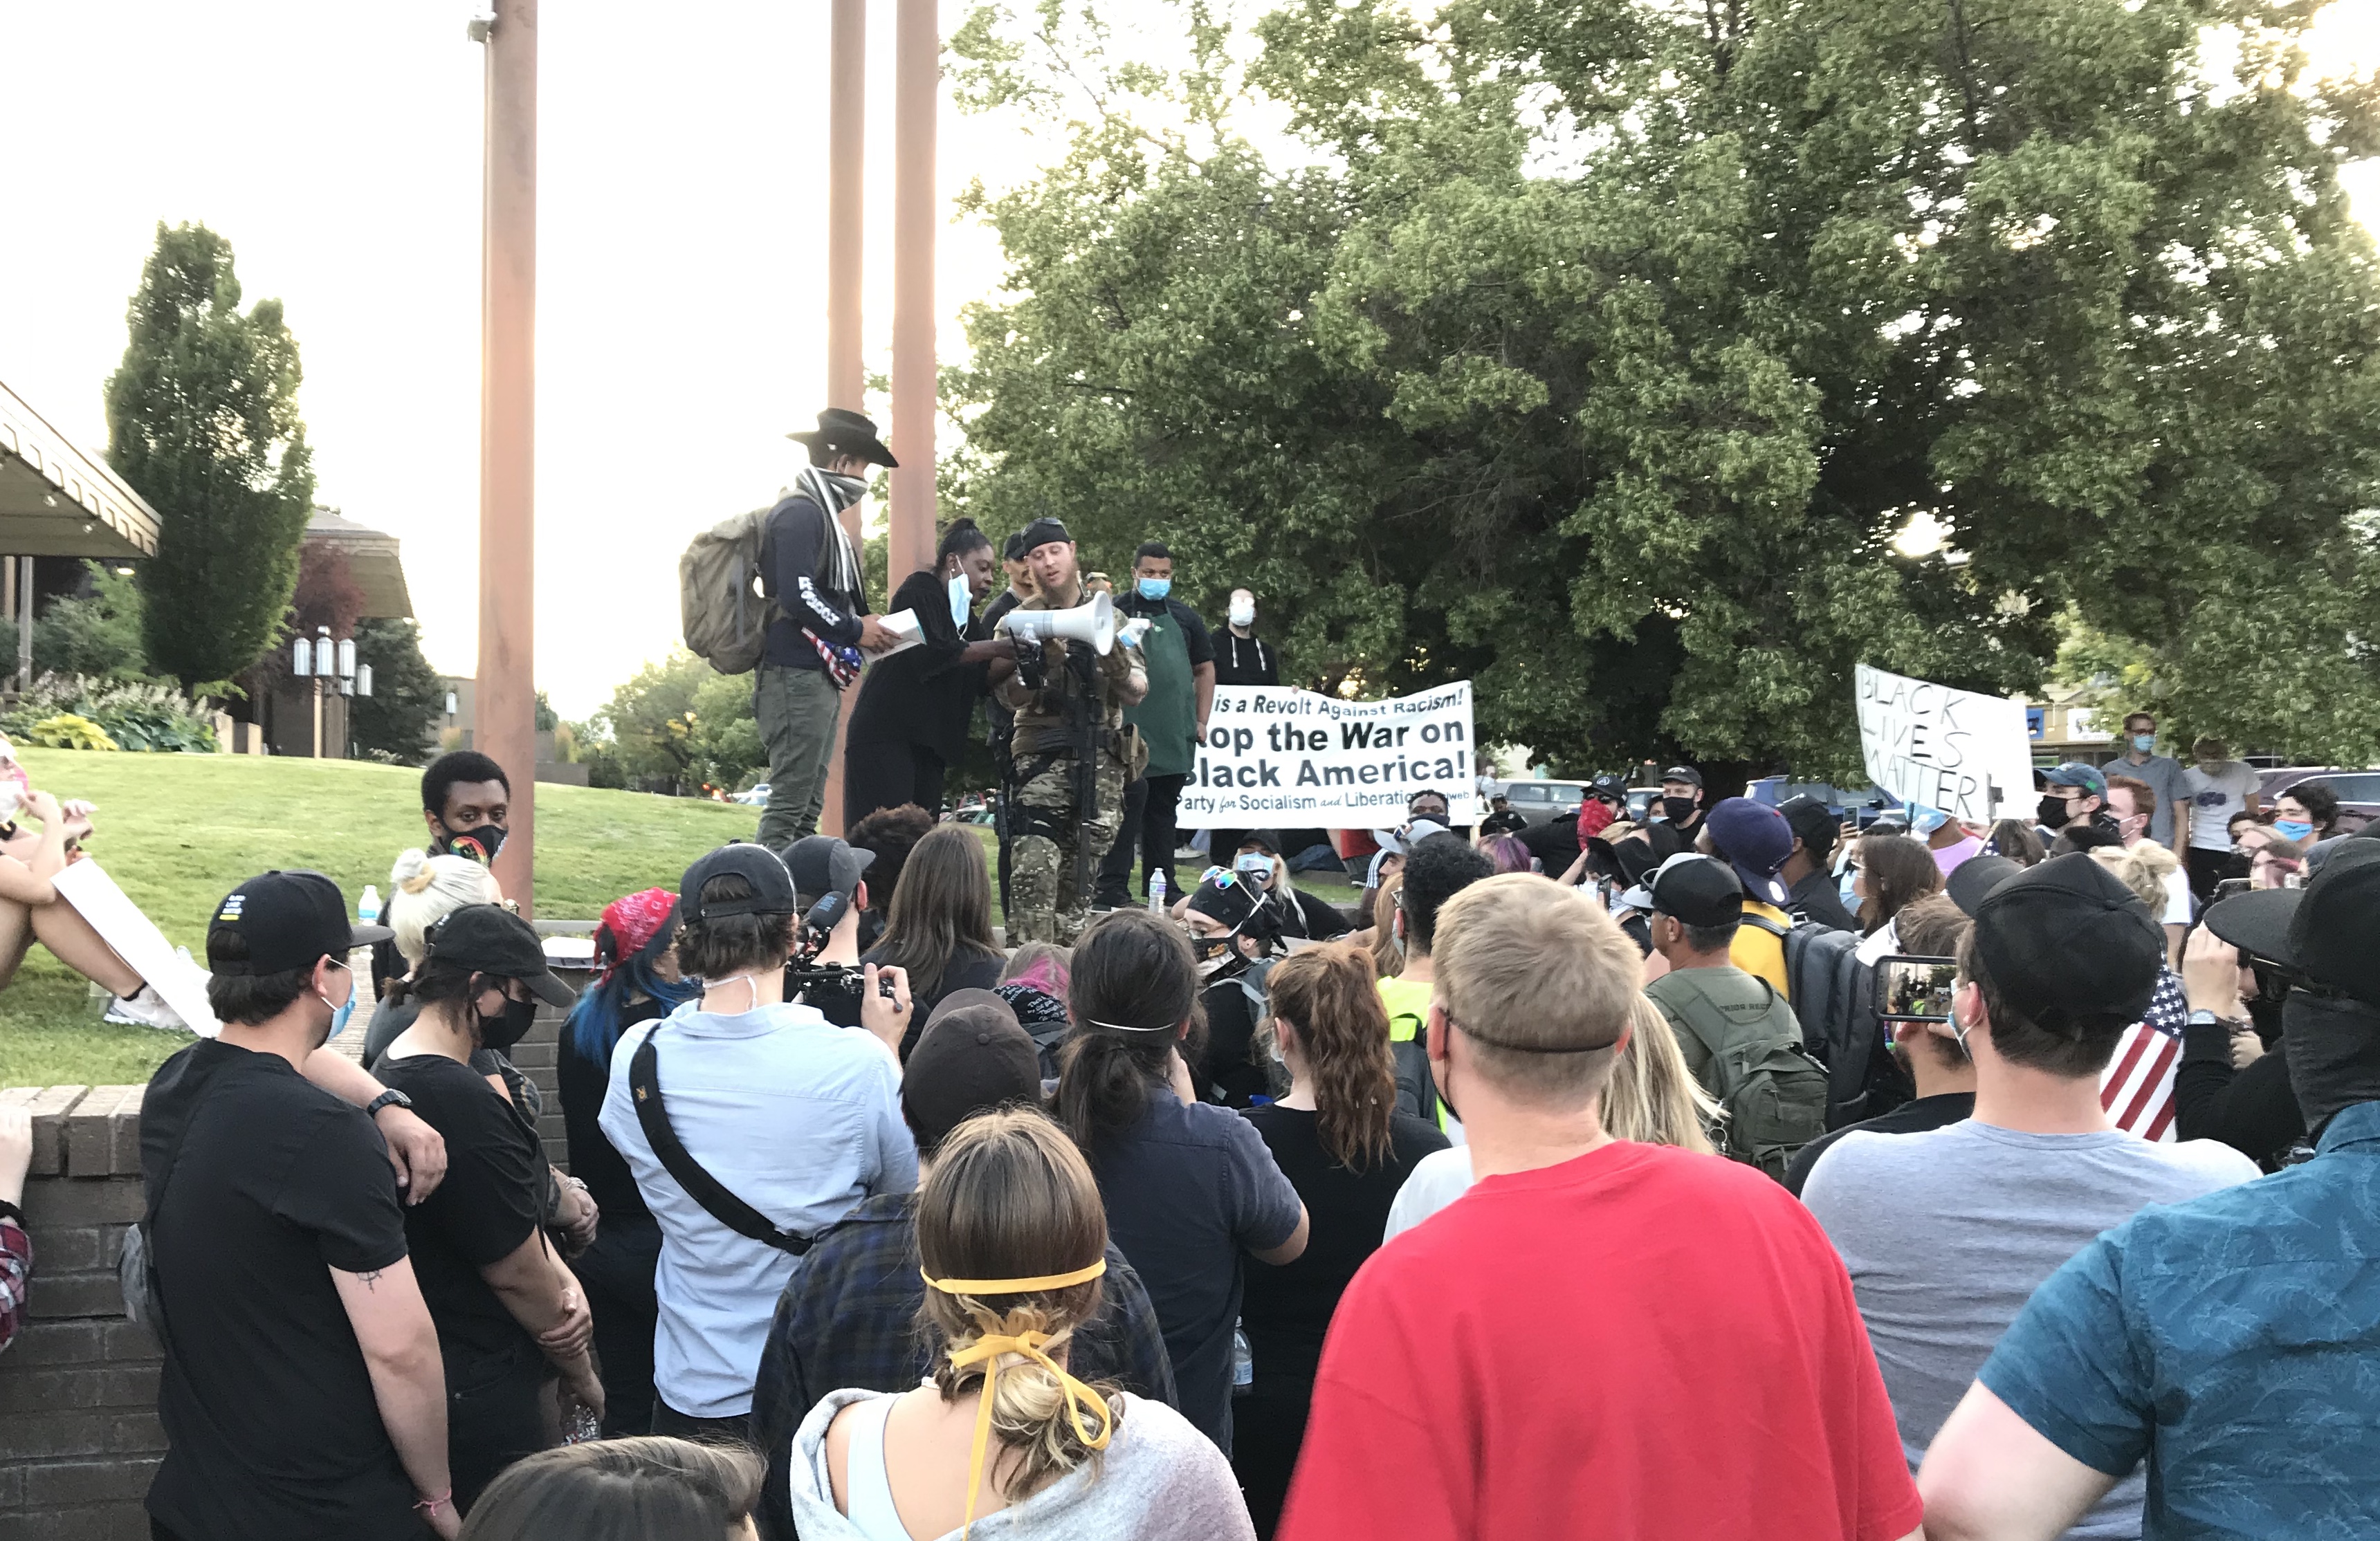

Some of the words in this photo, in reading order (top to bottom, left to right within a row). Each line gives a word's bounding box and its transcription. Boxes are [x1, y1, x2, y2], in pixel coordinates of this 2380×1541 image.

[1214, 694, 1231, 713] is
[1236, 699, 1247, 713] a
[1253, 694, 1312, 715] Revolt
[1317, 700, 1386, 721] Against
[1393, 688, 1464, 714] Racism!
[1862, 668, 1966, 729] BLACK
[1198, 726, 1254, 757] op
[1267, 721, 1328, 752] the
[1340, 721, 1411, 750] War
[1420, 720, 1465, 744] on
[1862, 706, 1971, 768] LIVES
[1295, 750, 1465, 787] America!
[1865, 742, 1977, 819] MATTER
[1219, 795, 1236, 813] for
[1239, 794, 1317, 811] Socialism
[1319, 795, 1342, 807] and
